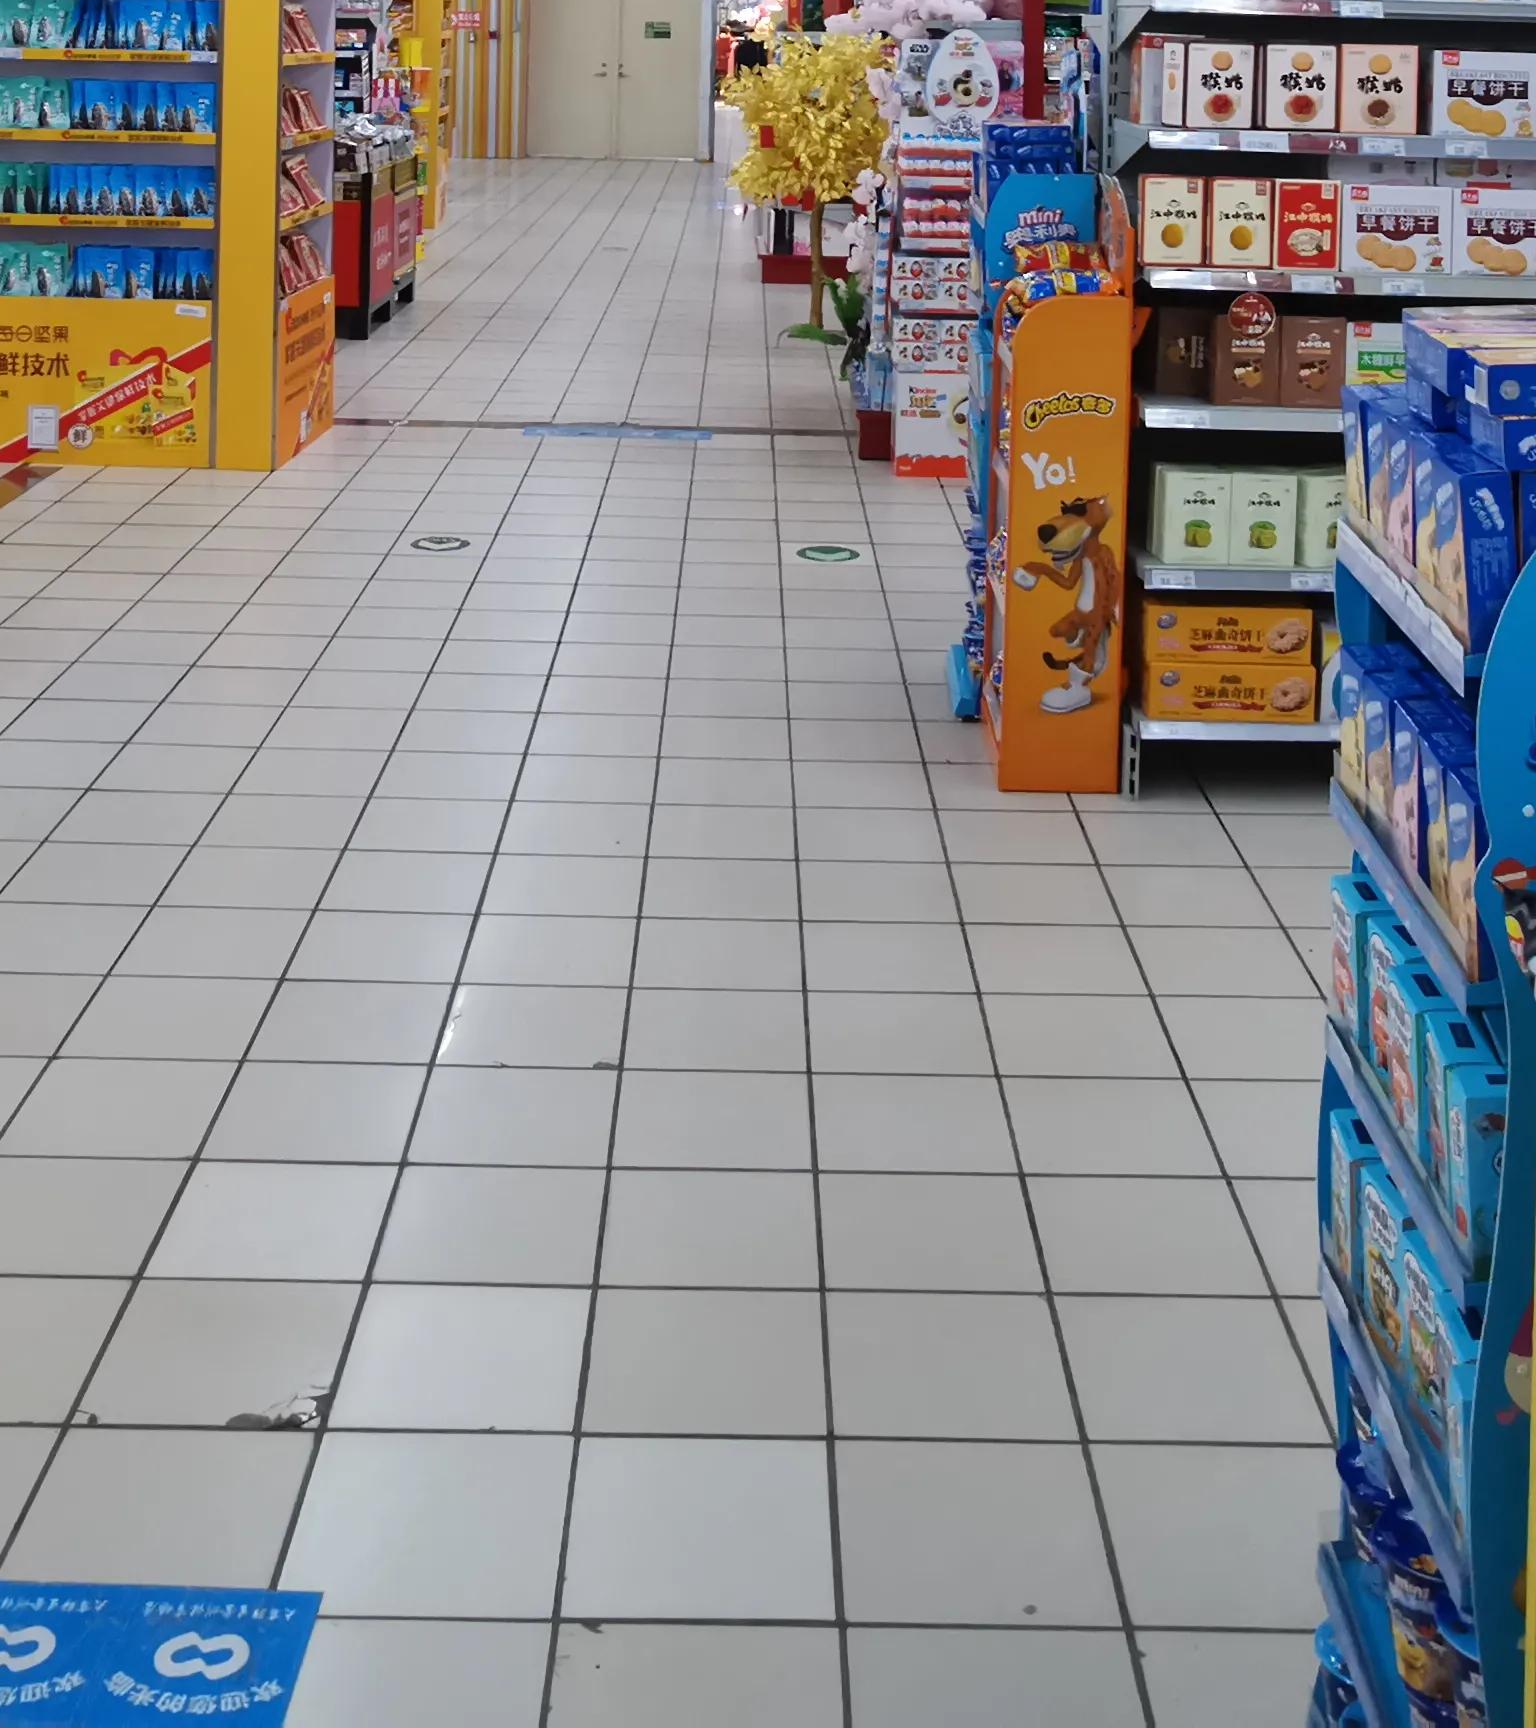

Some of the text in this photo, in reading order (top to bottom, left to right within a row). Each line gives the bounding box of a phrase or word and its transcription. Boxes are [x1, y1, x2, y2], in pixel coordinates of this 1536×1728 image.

[1451, 80, 1526, 98] 早餐饼干
[1018, 209, 1062, 227] mini
[1360, 215, 1435, 233] 早餐饼干
[1004, 224, 1076, 249] 奥利奥
[1021, 452, 1076, 490] Yo!
[104, 1671, 284, 1715] 欢迎您的光临
